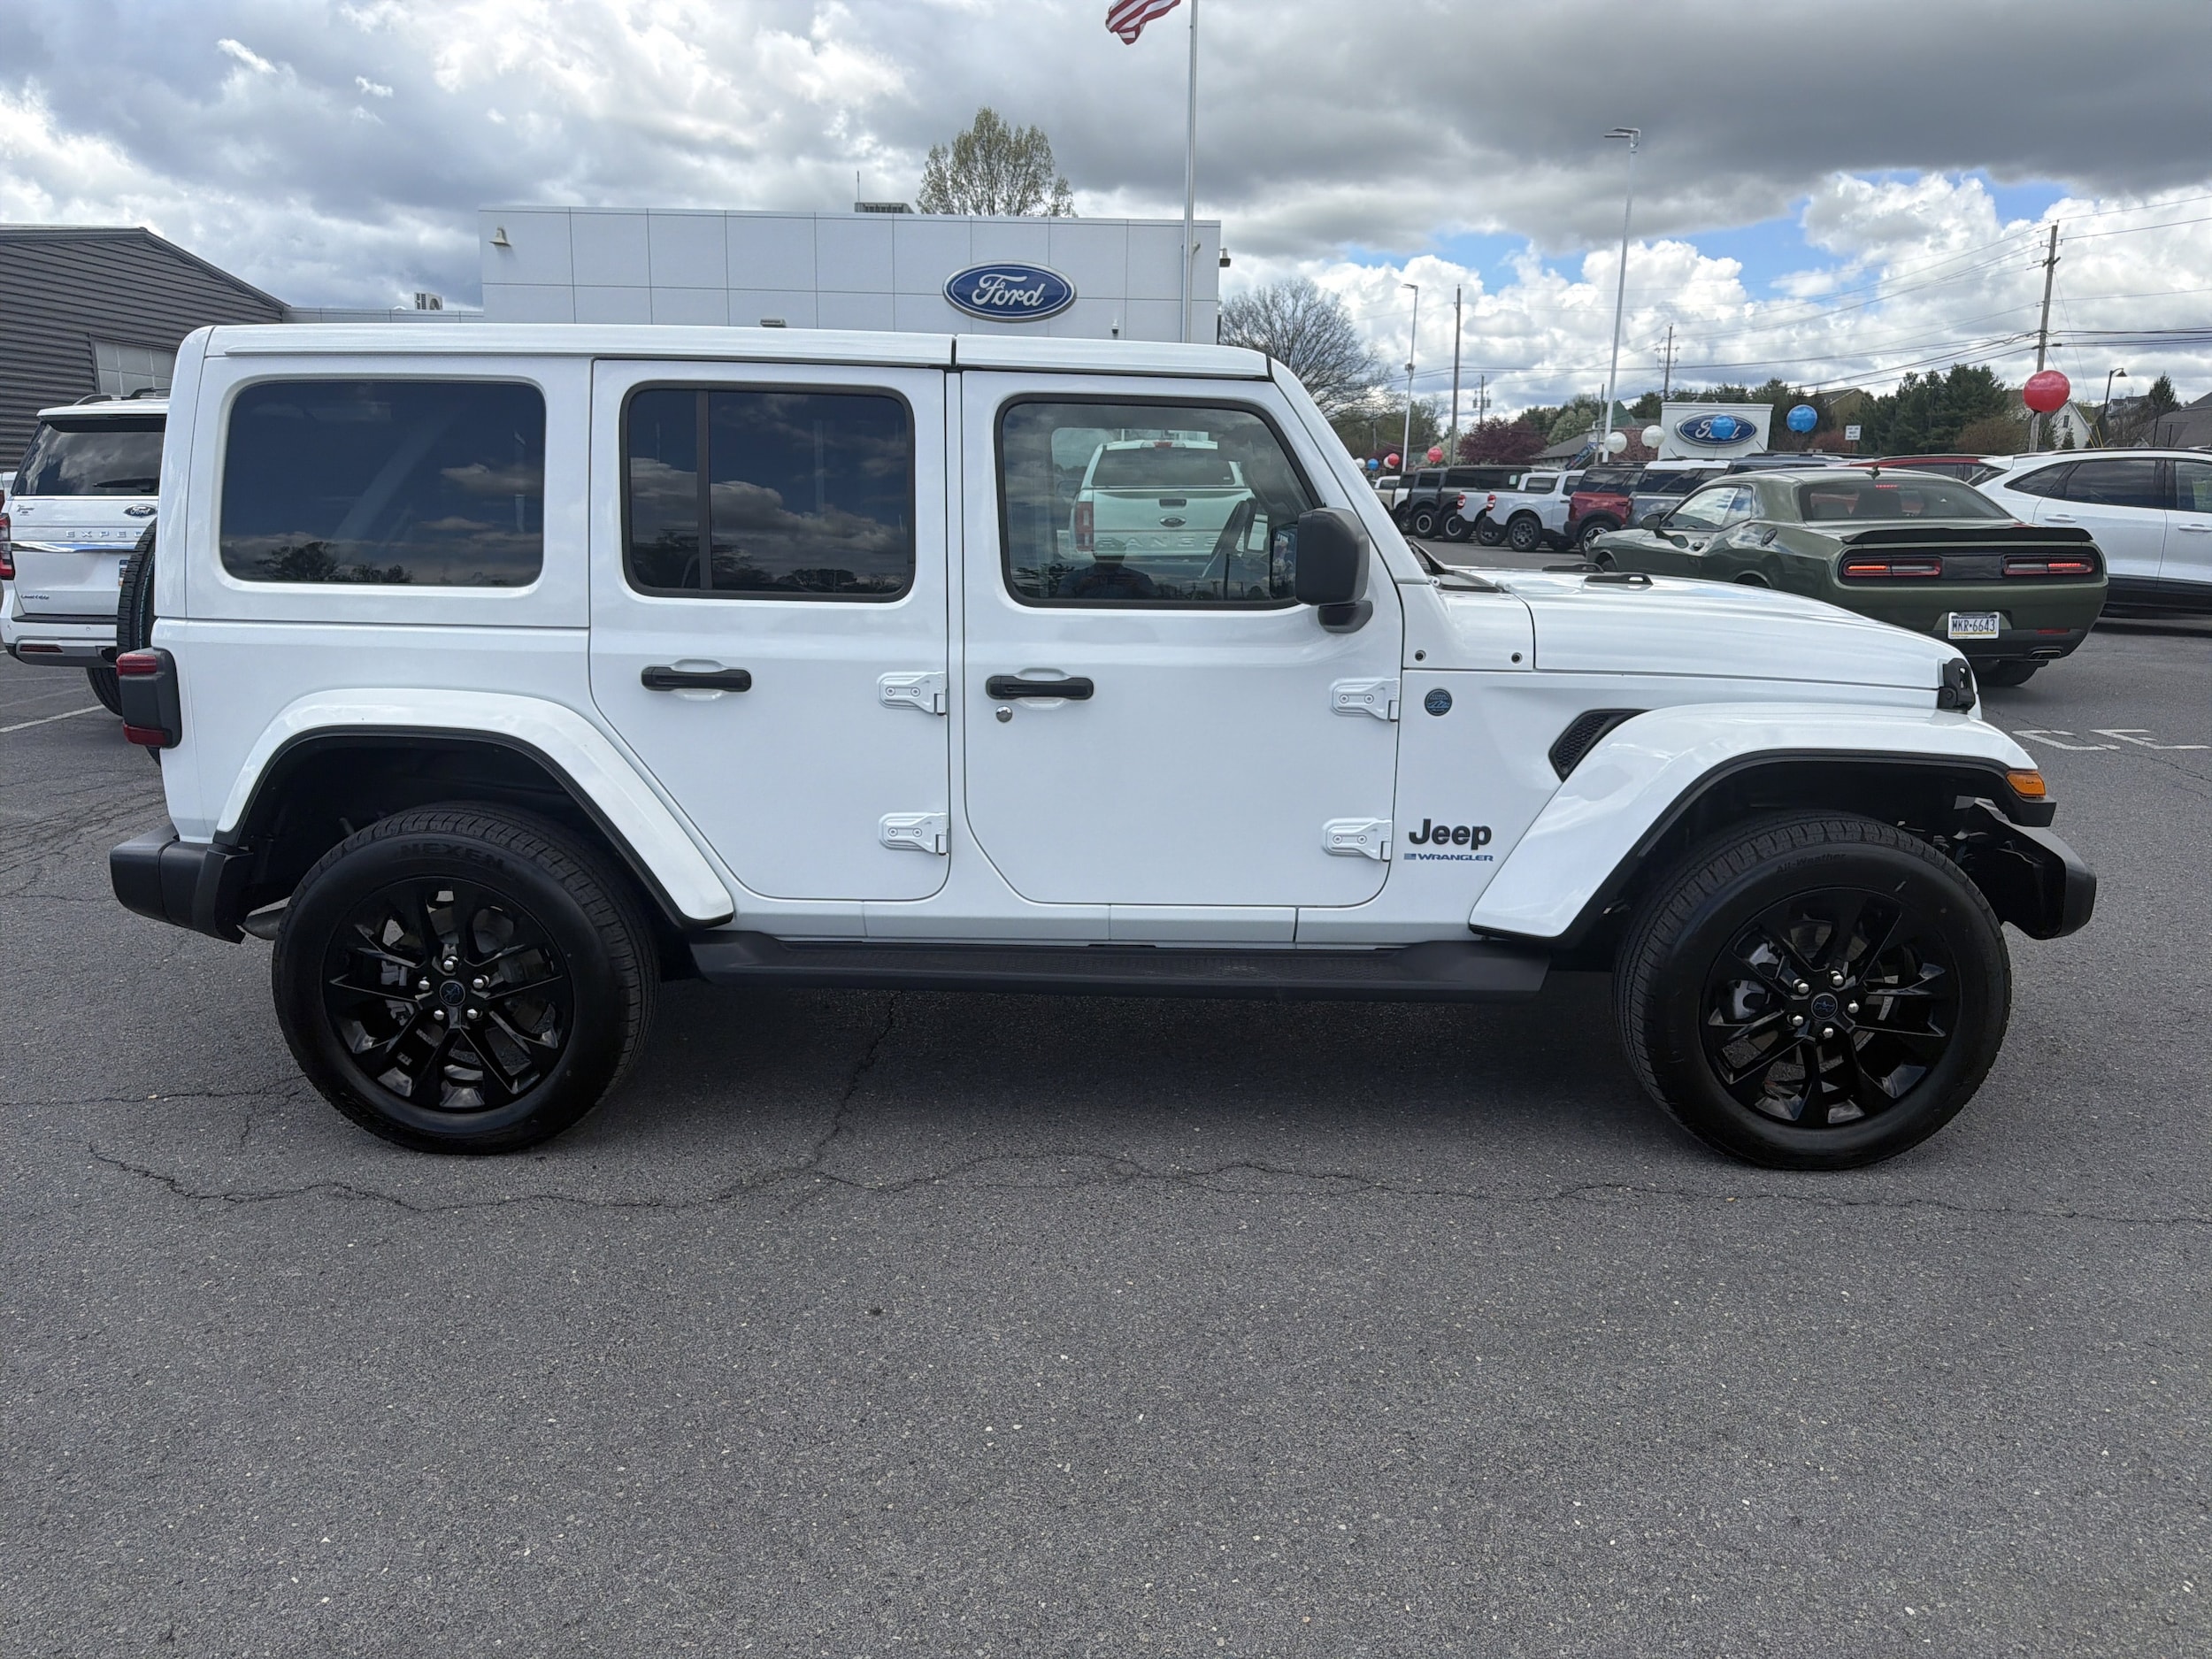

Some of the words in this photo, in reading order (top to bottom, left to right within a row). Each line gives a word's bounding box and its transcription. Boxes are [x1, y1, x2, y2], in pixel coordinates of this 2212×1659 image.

[972, 273, 1046, 307] Ford
[1409, 818, 1492, 850] Jeep
[400, 842, 504, 868] NEXEN
